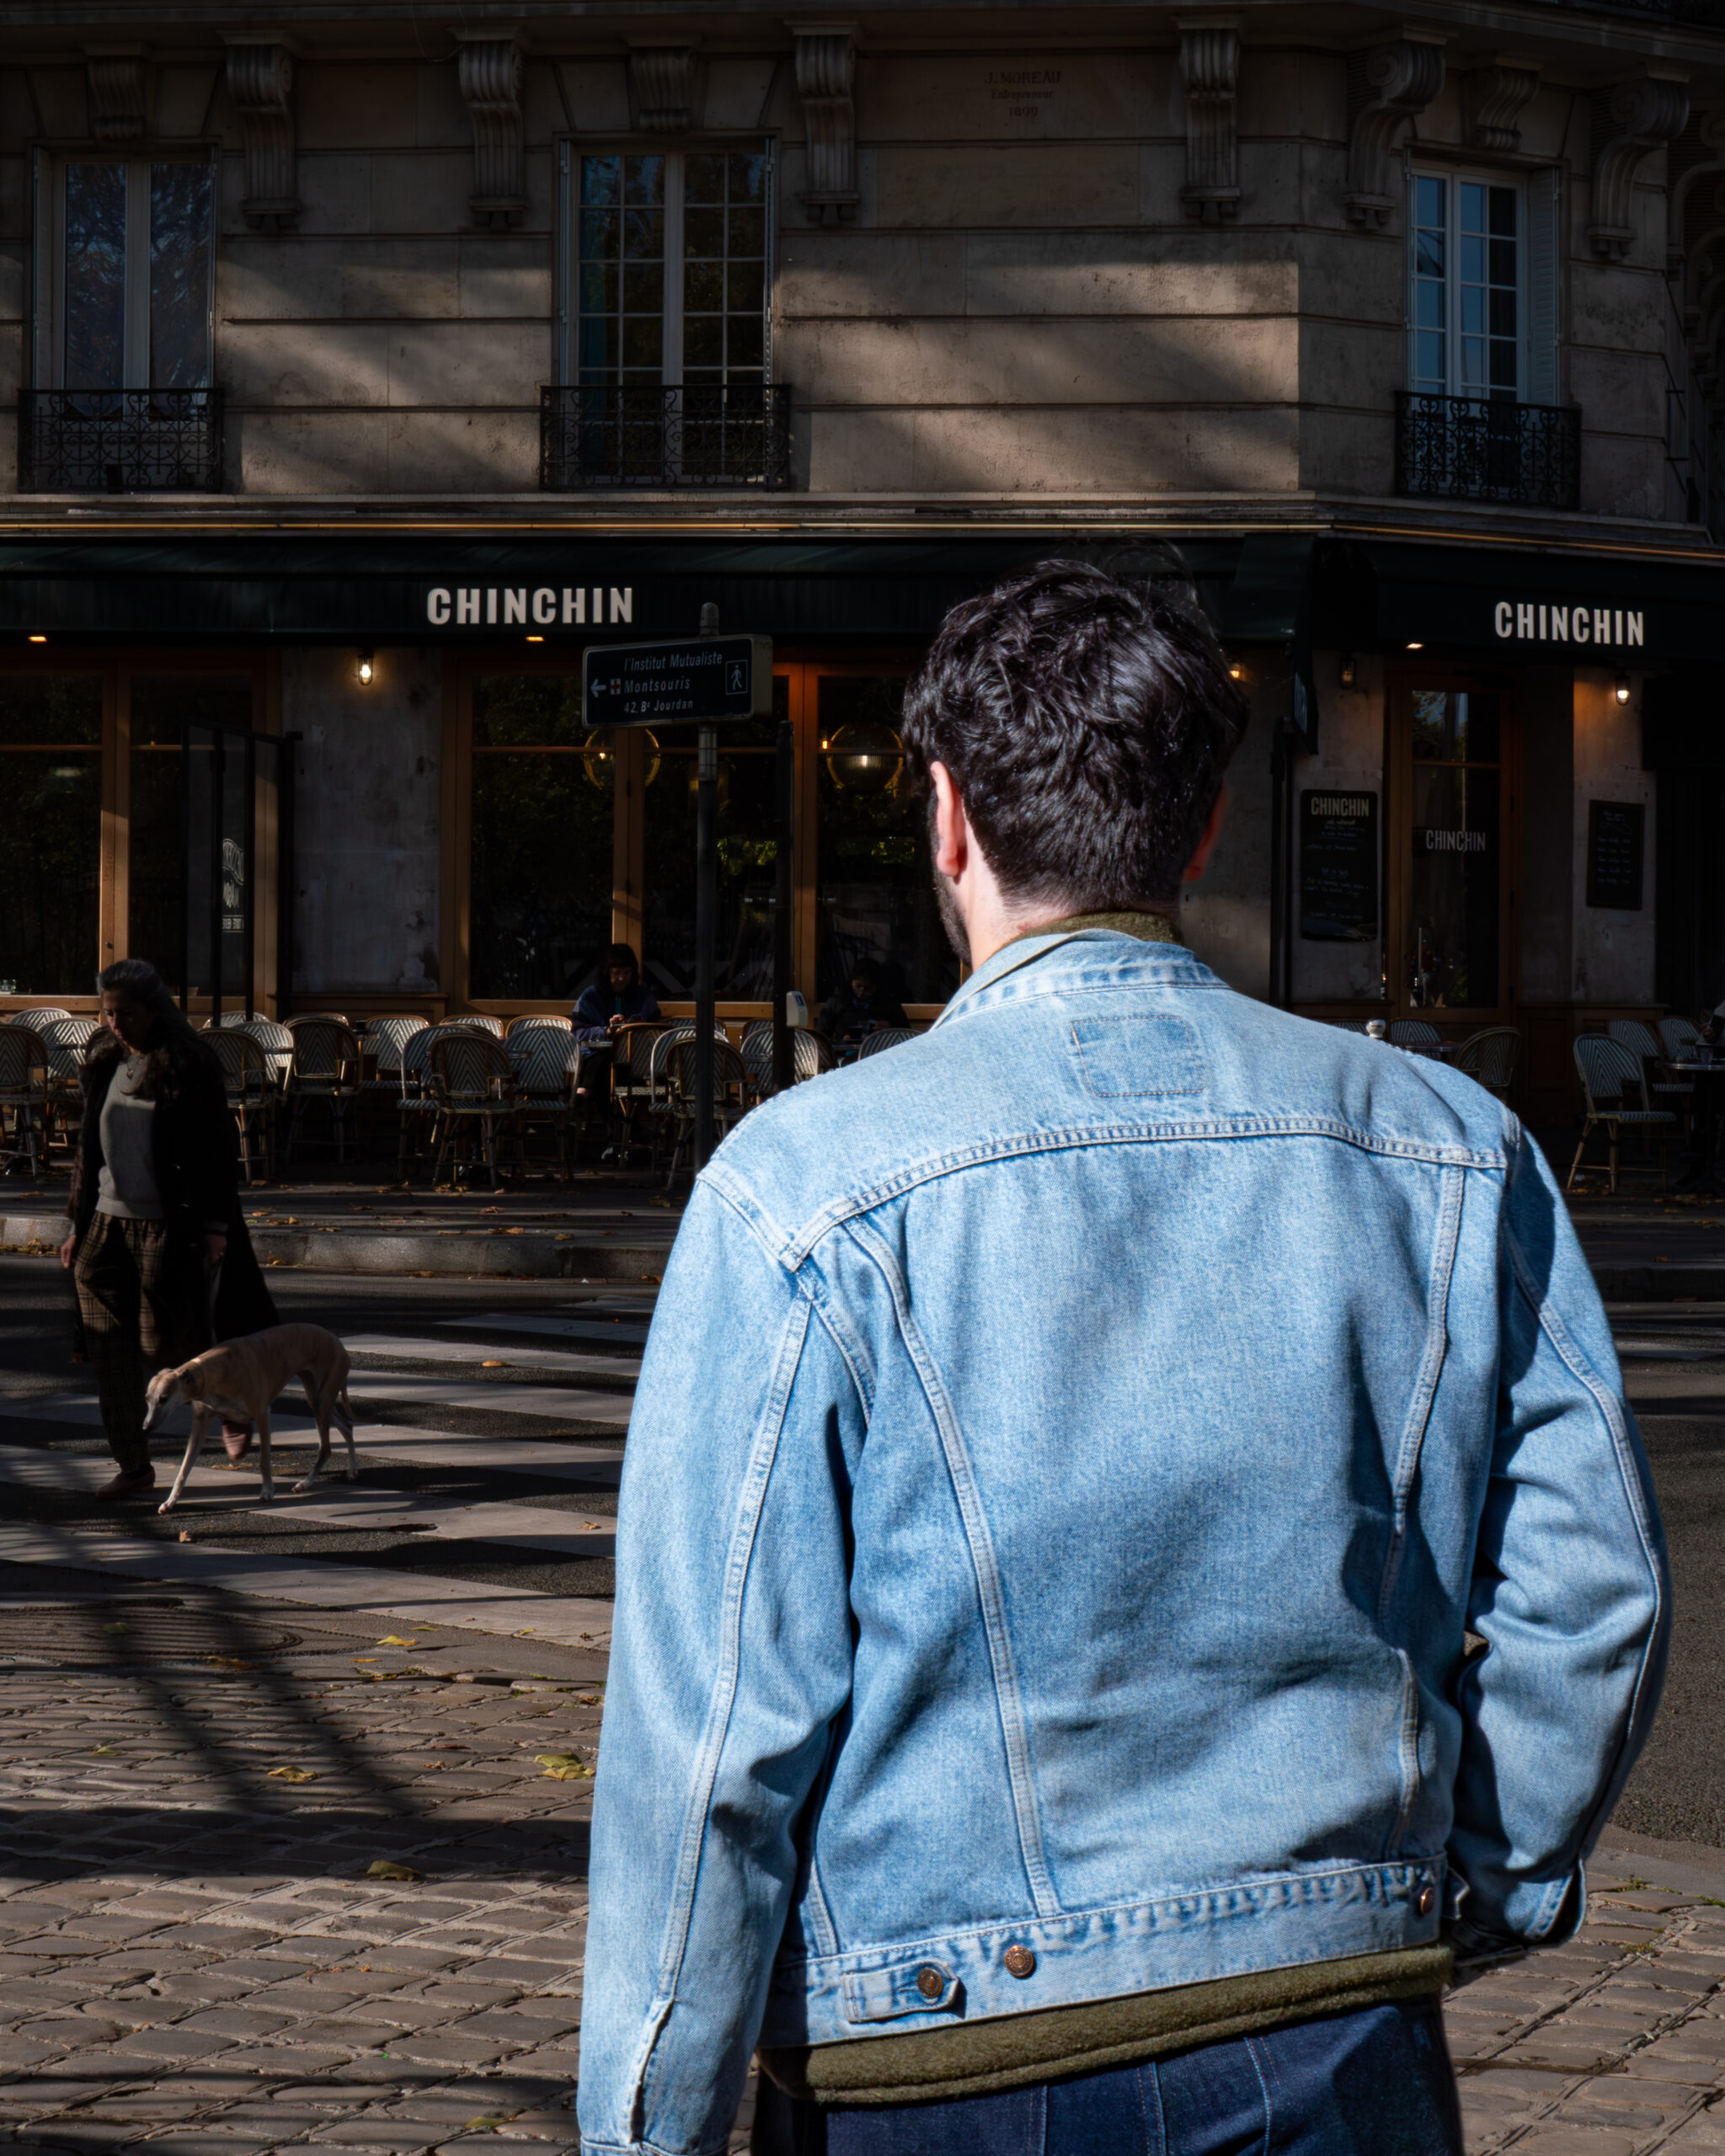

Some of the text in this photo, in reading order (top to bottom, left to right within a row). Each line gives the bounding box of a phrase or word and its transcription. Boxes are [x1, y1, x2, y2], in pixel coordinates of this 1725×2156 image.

[991, 88, 1053, 103] Entrepreneur
[427, 588, 632, 625] CHINCHIN
[1494, 601, 1643, 647] CHINCHIN
[669, 650, 723, 668] Mutualiste
[623, 675, 692, 694] Montsouris
[654, 698, 694, 712] Jourdan
[1310, 797, 1370, 817] CHINCHIN
[1425, 829, 1486, 851] CHINCHIN
